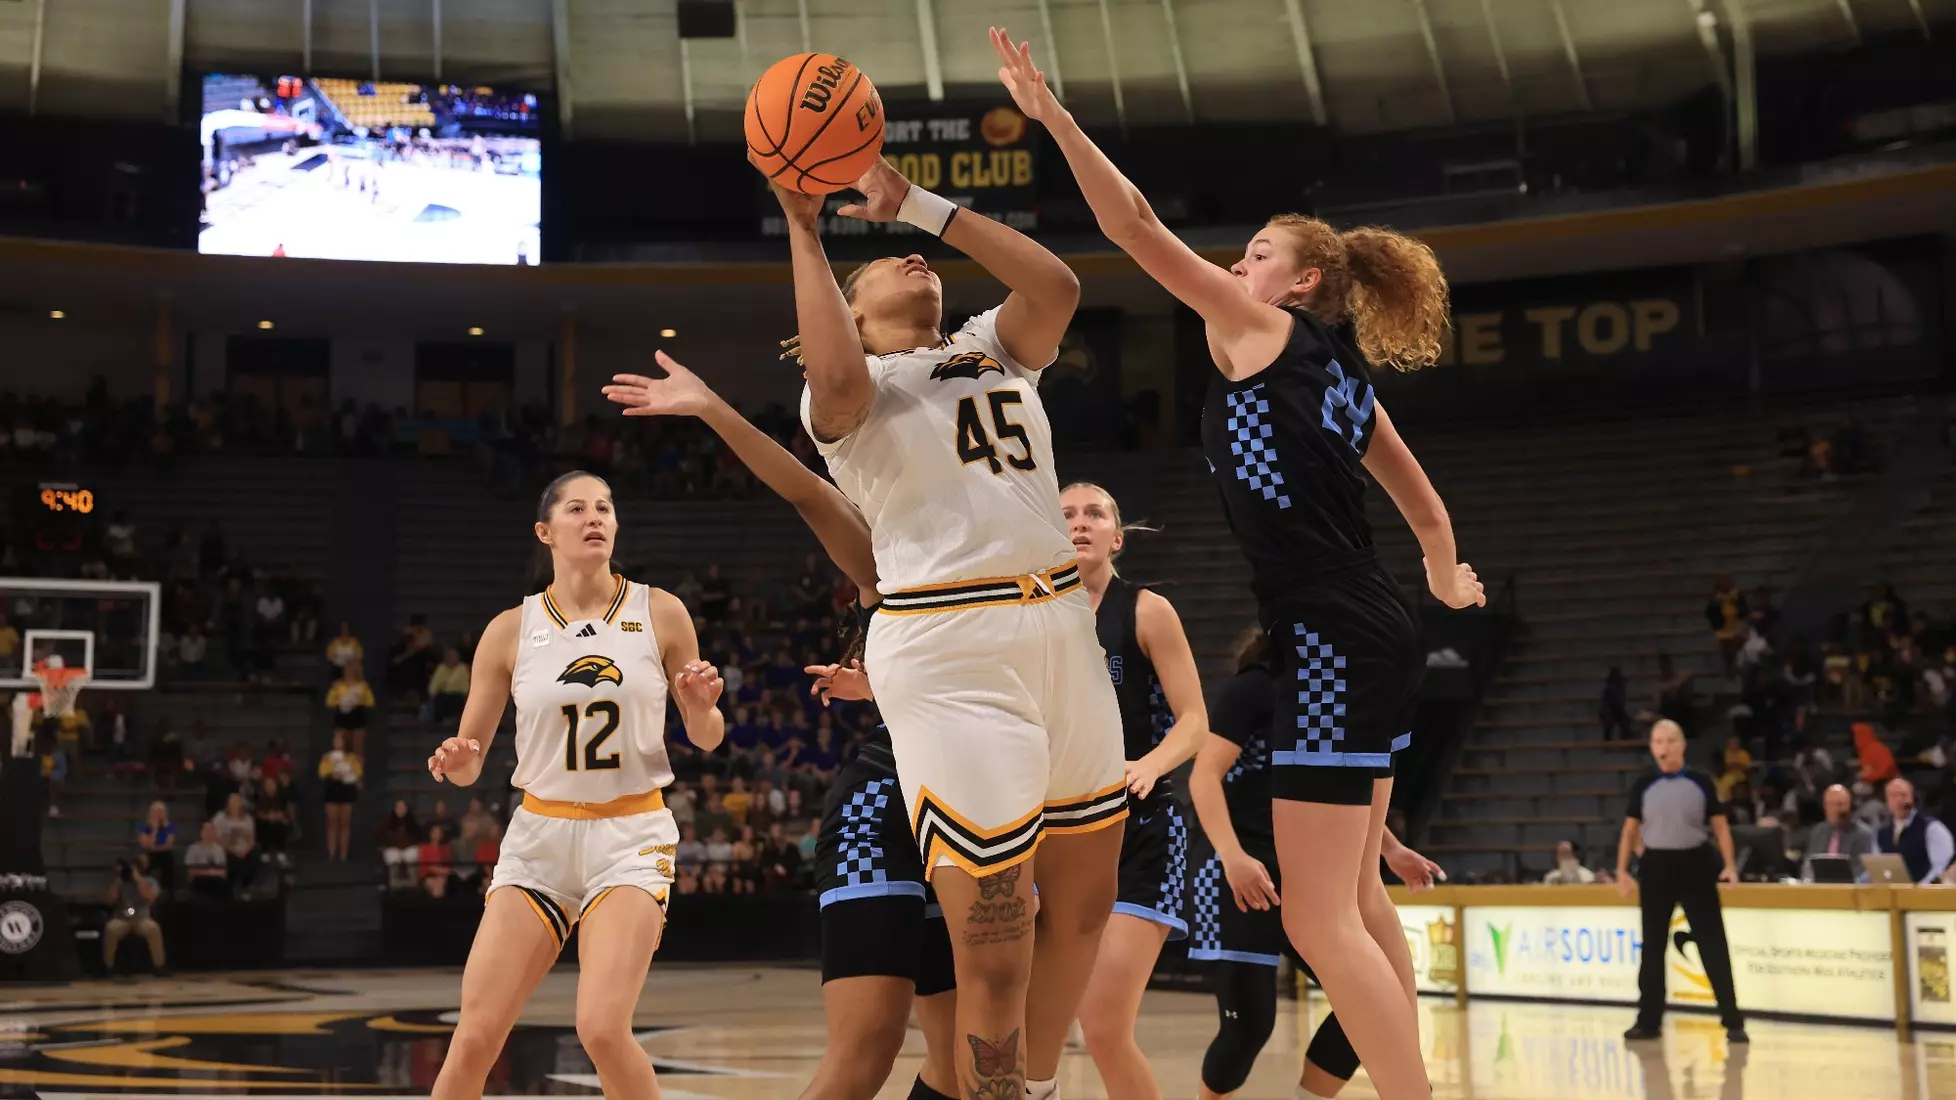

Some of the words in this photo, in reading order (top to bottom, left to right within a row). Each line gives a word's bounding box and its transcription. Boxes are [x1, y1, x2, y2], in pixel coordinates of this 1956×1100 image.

[856, 90, 881, 132] EV
[885, 119, 924, 143] ORT
[927, 118, 971, 141] THE
[951, 149, 1034, 188] CLUB
[1525, 298, 1681, 360] TOP
[955, 388, 1037, 476] 45
[41, 488, 94, 513] 9:40
[561, 699, 620, 772] 12
